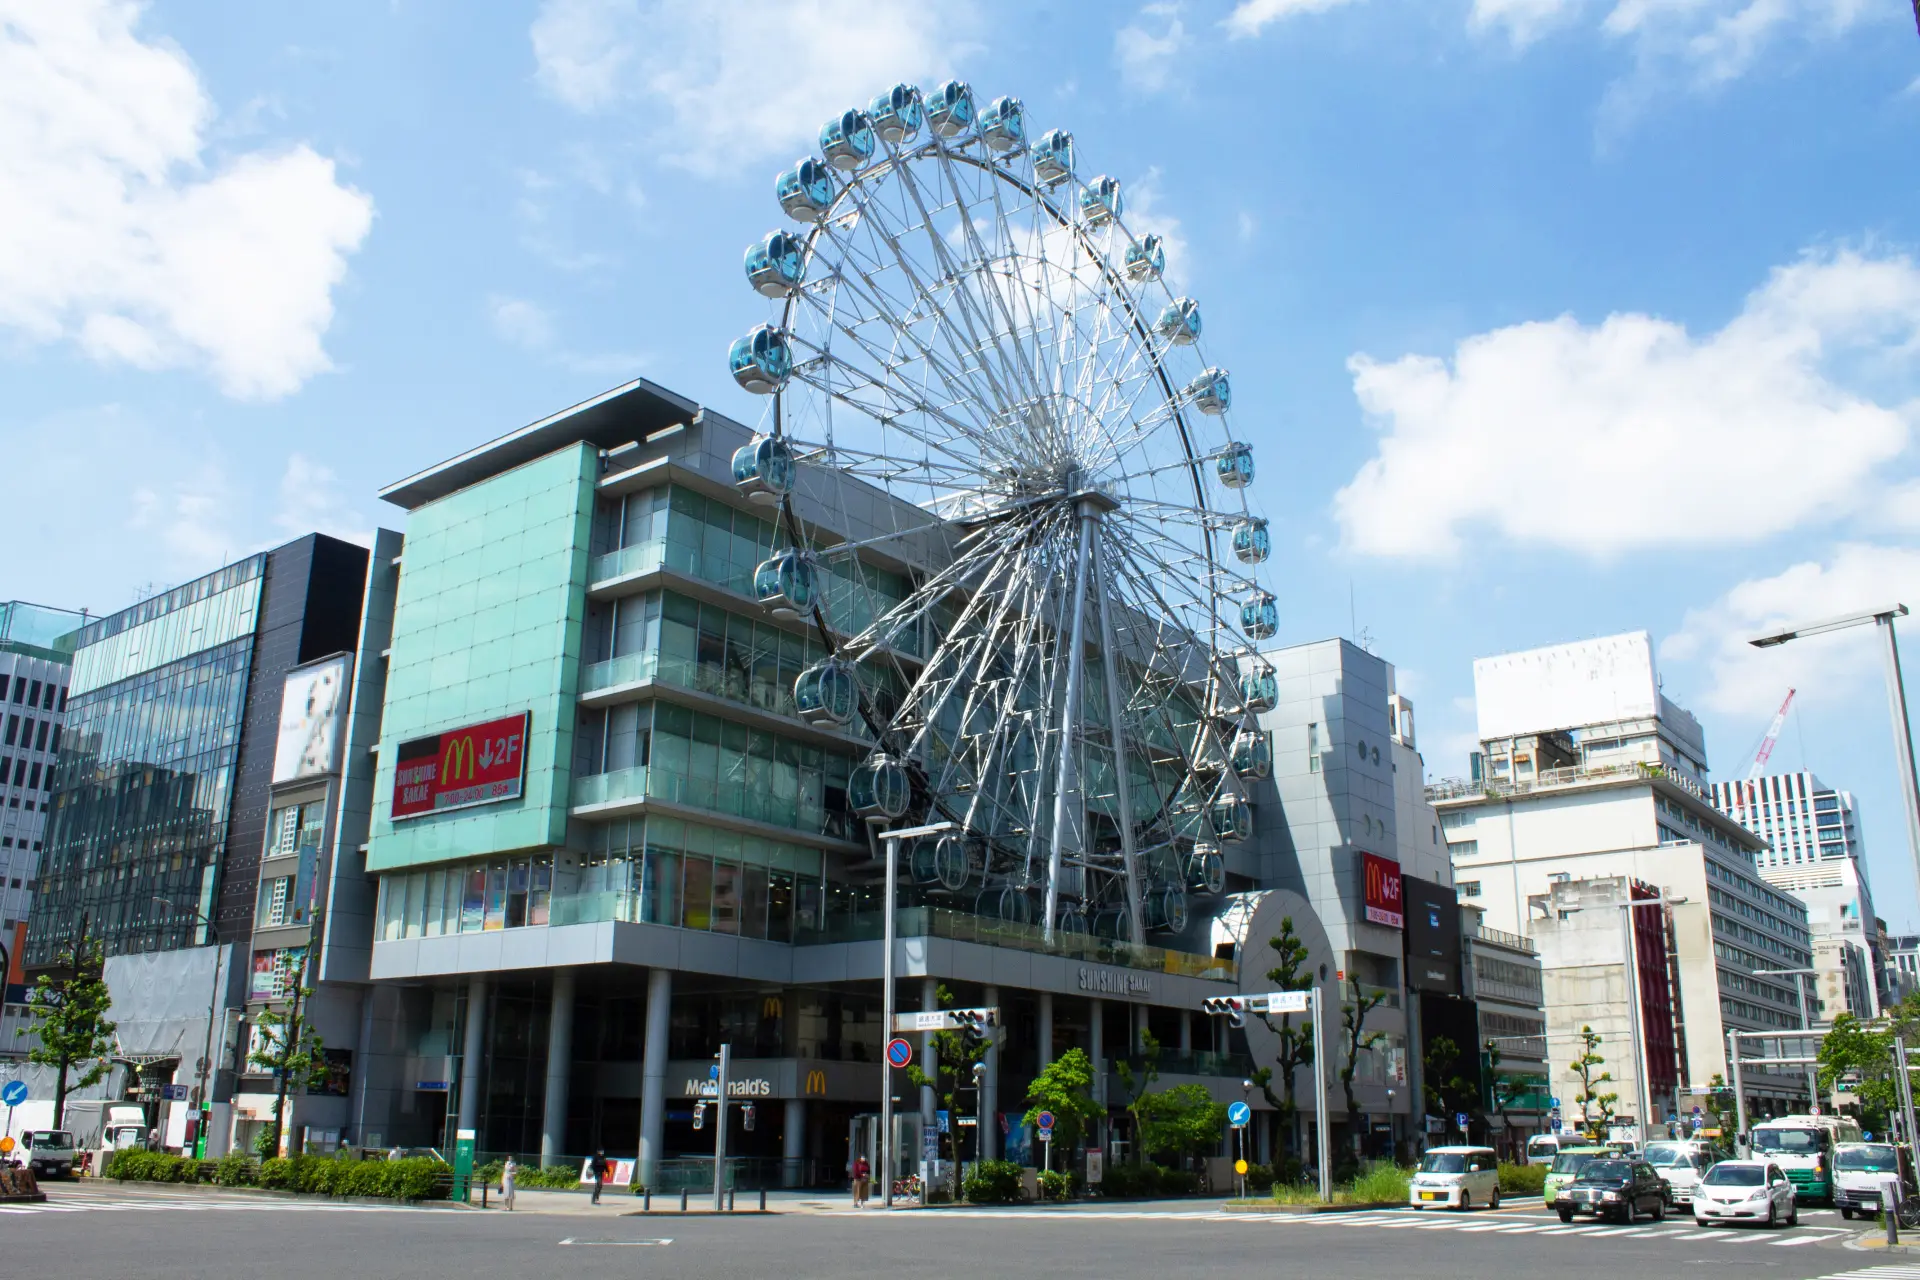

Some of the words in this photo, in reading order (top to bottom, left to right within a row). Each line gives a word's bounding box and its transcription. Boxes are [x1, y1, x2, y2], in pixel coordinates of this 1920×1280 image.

[494, 734, 520, 765] 2F
[397, 763, 437, 787] SUNSHINE
[403, 783, 429, 805] SAKAE
[1388, 878, 1399, 900] 2F
[1079, 967, 1129, 995] SUNSHINE
[685, 1079, 770, 1095] McDnald's
